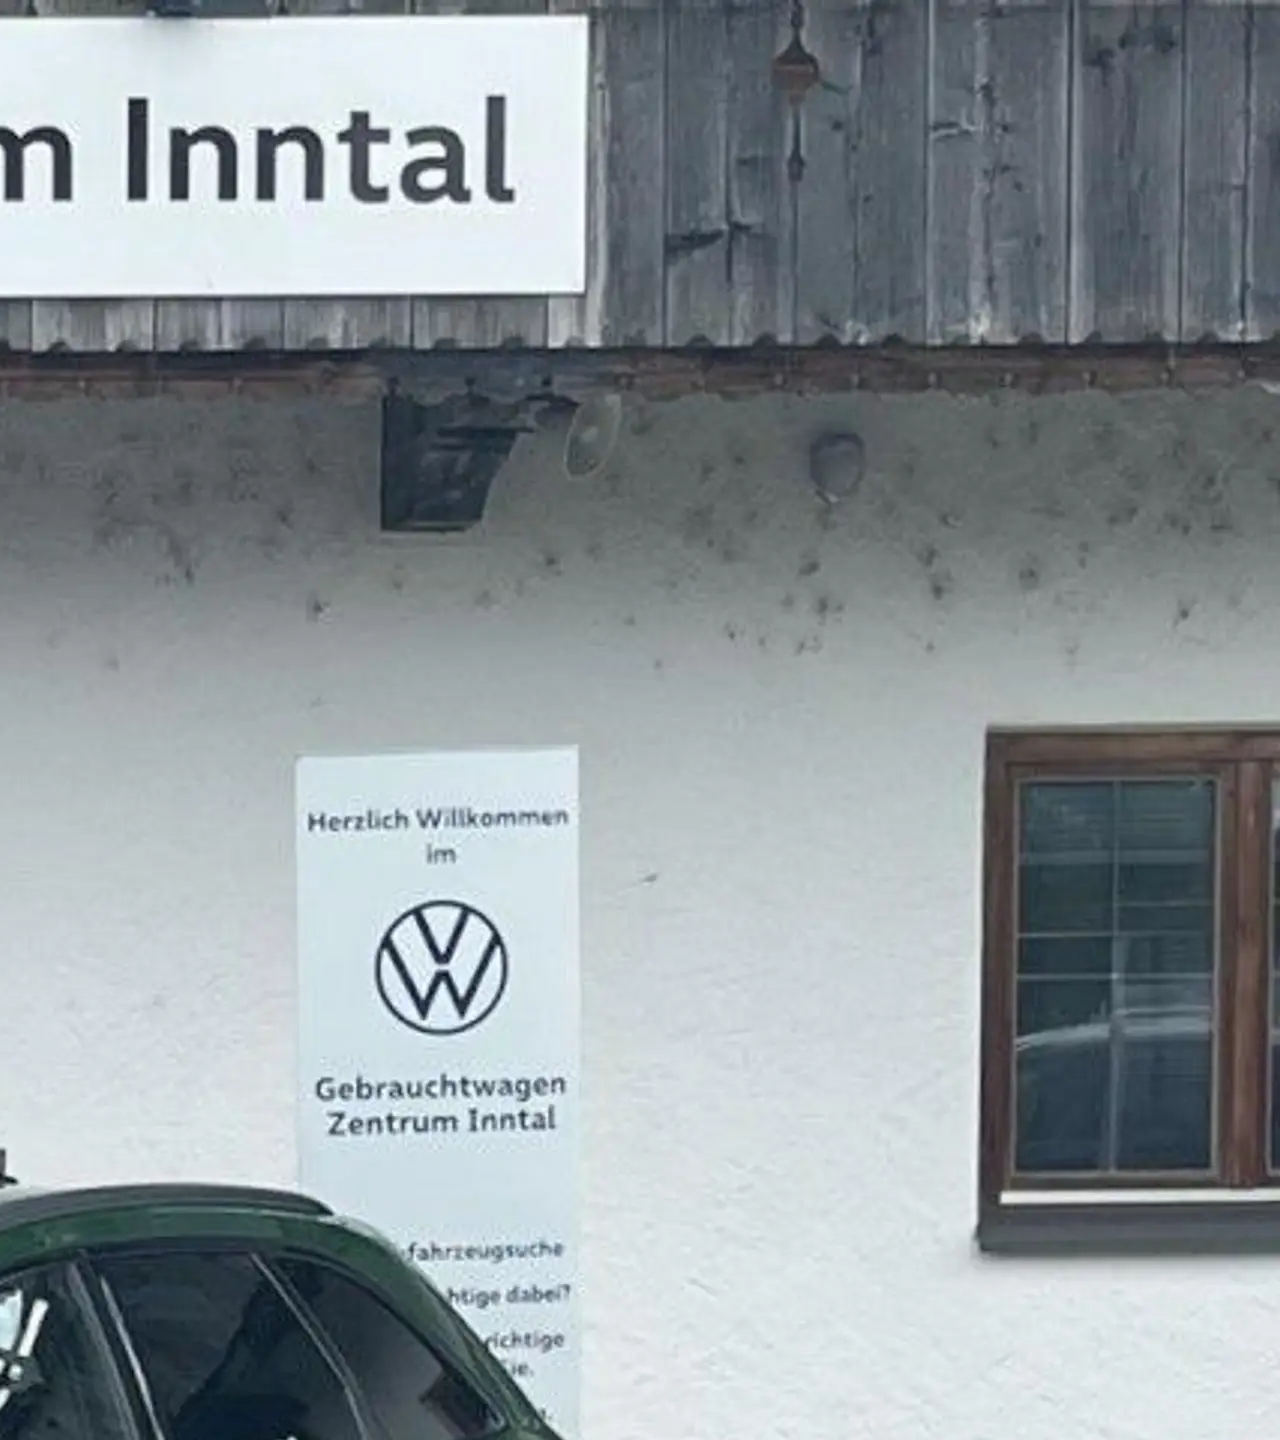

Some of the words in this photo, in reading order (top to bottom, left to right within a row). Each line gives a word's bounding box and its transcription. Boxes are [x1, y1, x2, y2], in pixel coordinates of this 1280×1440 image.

[126, 93, 516, 205] Inntal
[307, 807, 410, 833] Herzlich
[415, 805, 569, 831] Willkommen
[425, 842, 458, 865] im
[375, 900, 508, 1036] VW
[314, 1072, 567, 1104] Gebrauchtwagen
[326, 1109, 459, 1137] Zentrum
[467, 1104, 557, 1134] Inntal
[403, 1241, 564, 1263] fahrzeugsuche
[447, 1286, 502, 1309] htige
[506, 1283, 571, 1304] dabei?
